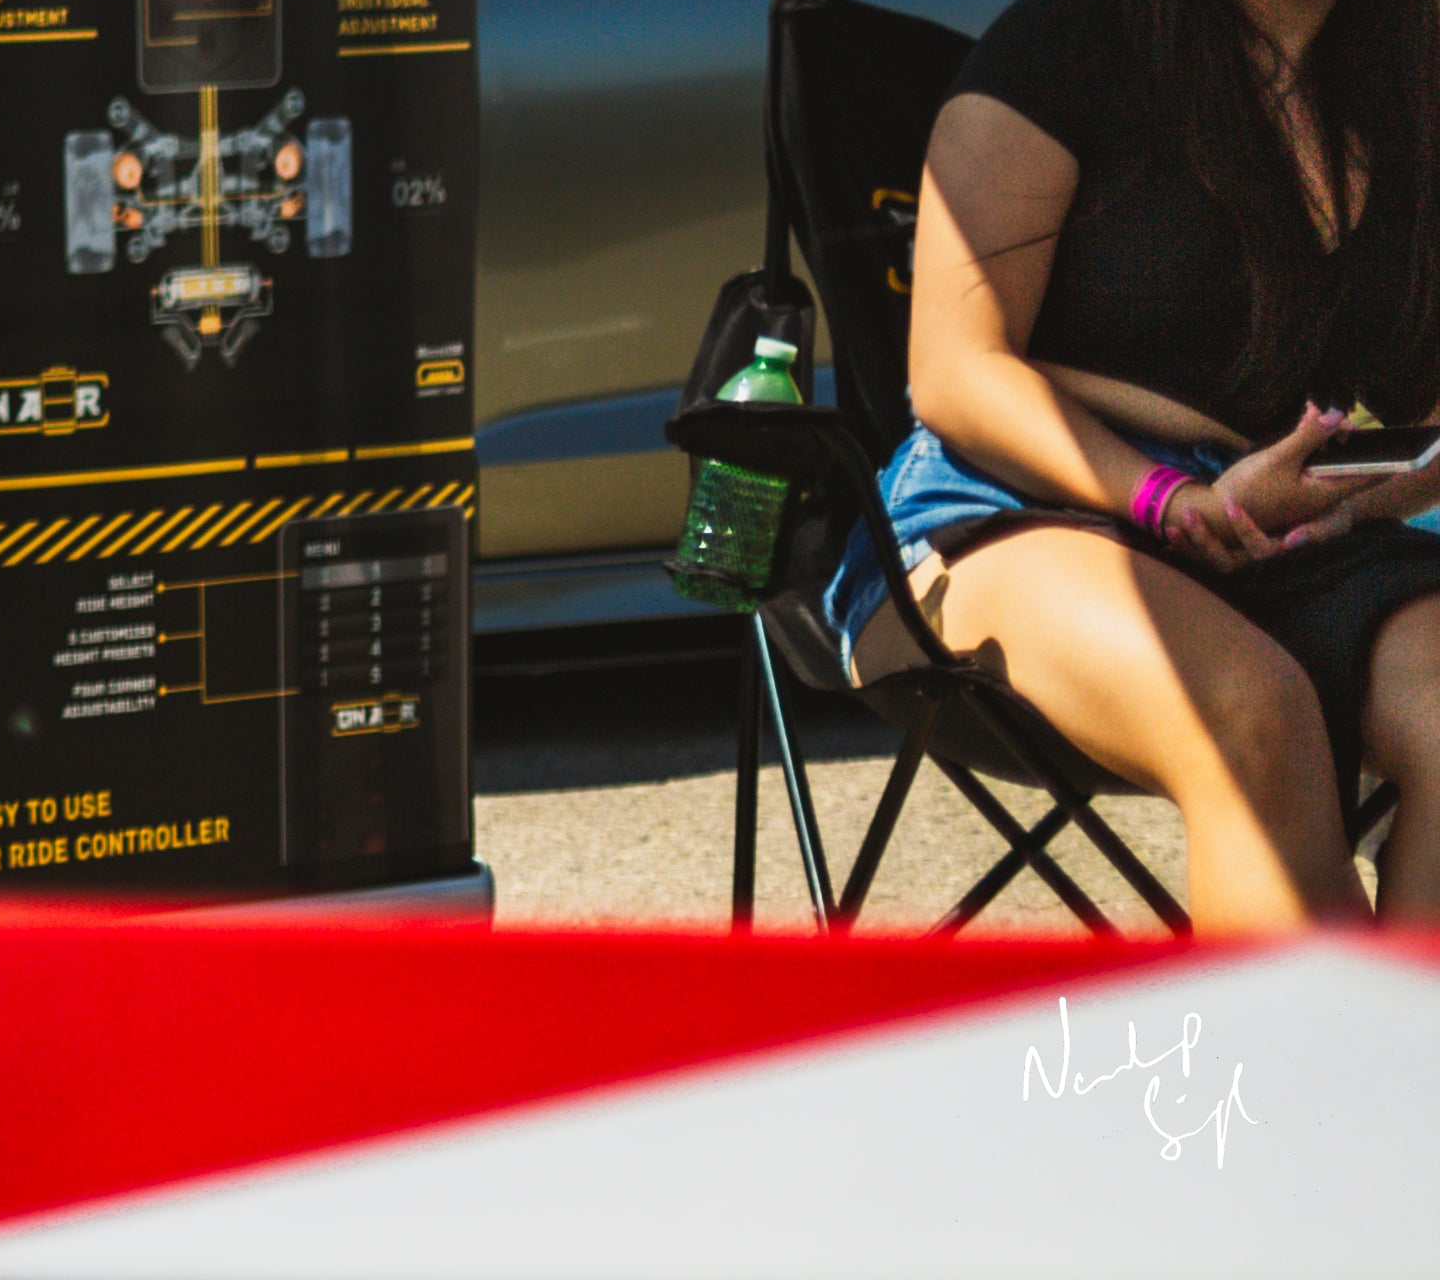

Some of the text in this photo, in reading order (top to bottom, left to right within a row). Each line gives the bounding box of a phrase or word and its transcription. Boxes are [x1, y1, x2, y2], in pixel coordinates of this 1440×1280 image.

[337, 12, 438, 35] ADJUSTMENT
[25, 797, 58, 826] TO
[63, 790, 113, 823] USE
[8, 837, 70, 869] RIDE
[75, 815, 231, 861] CONTROLLER
